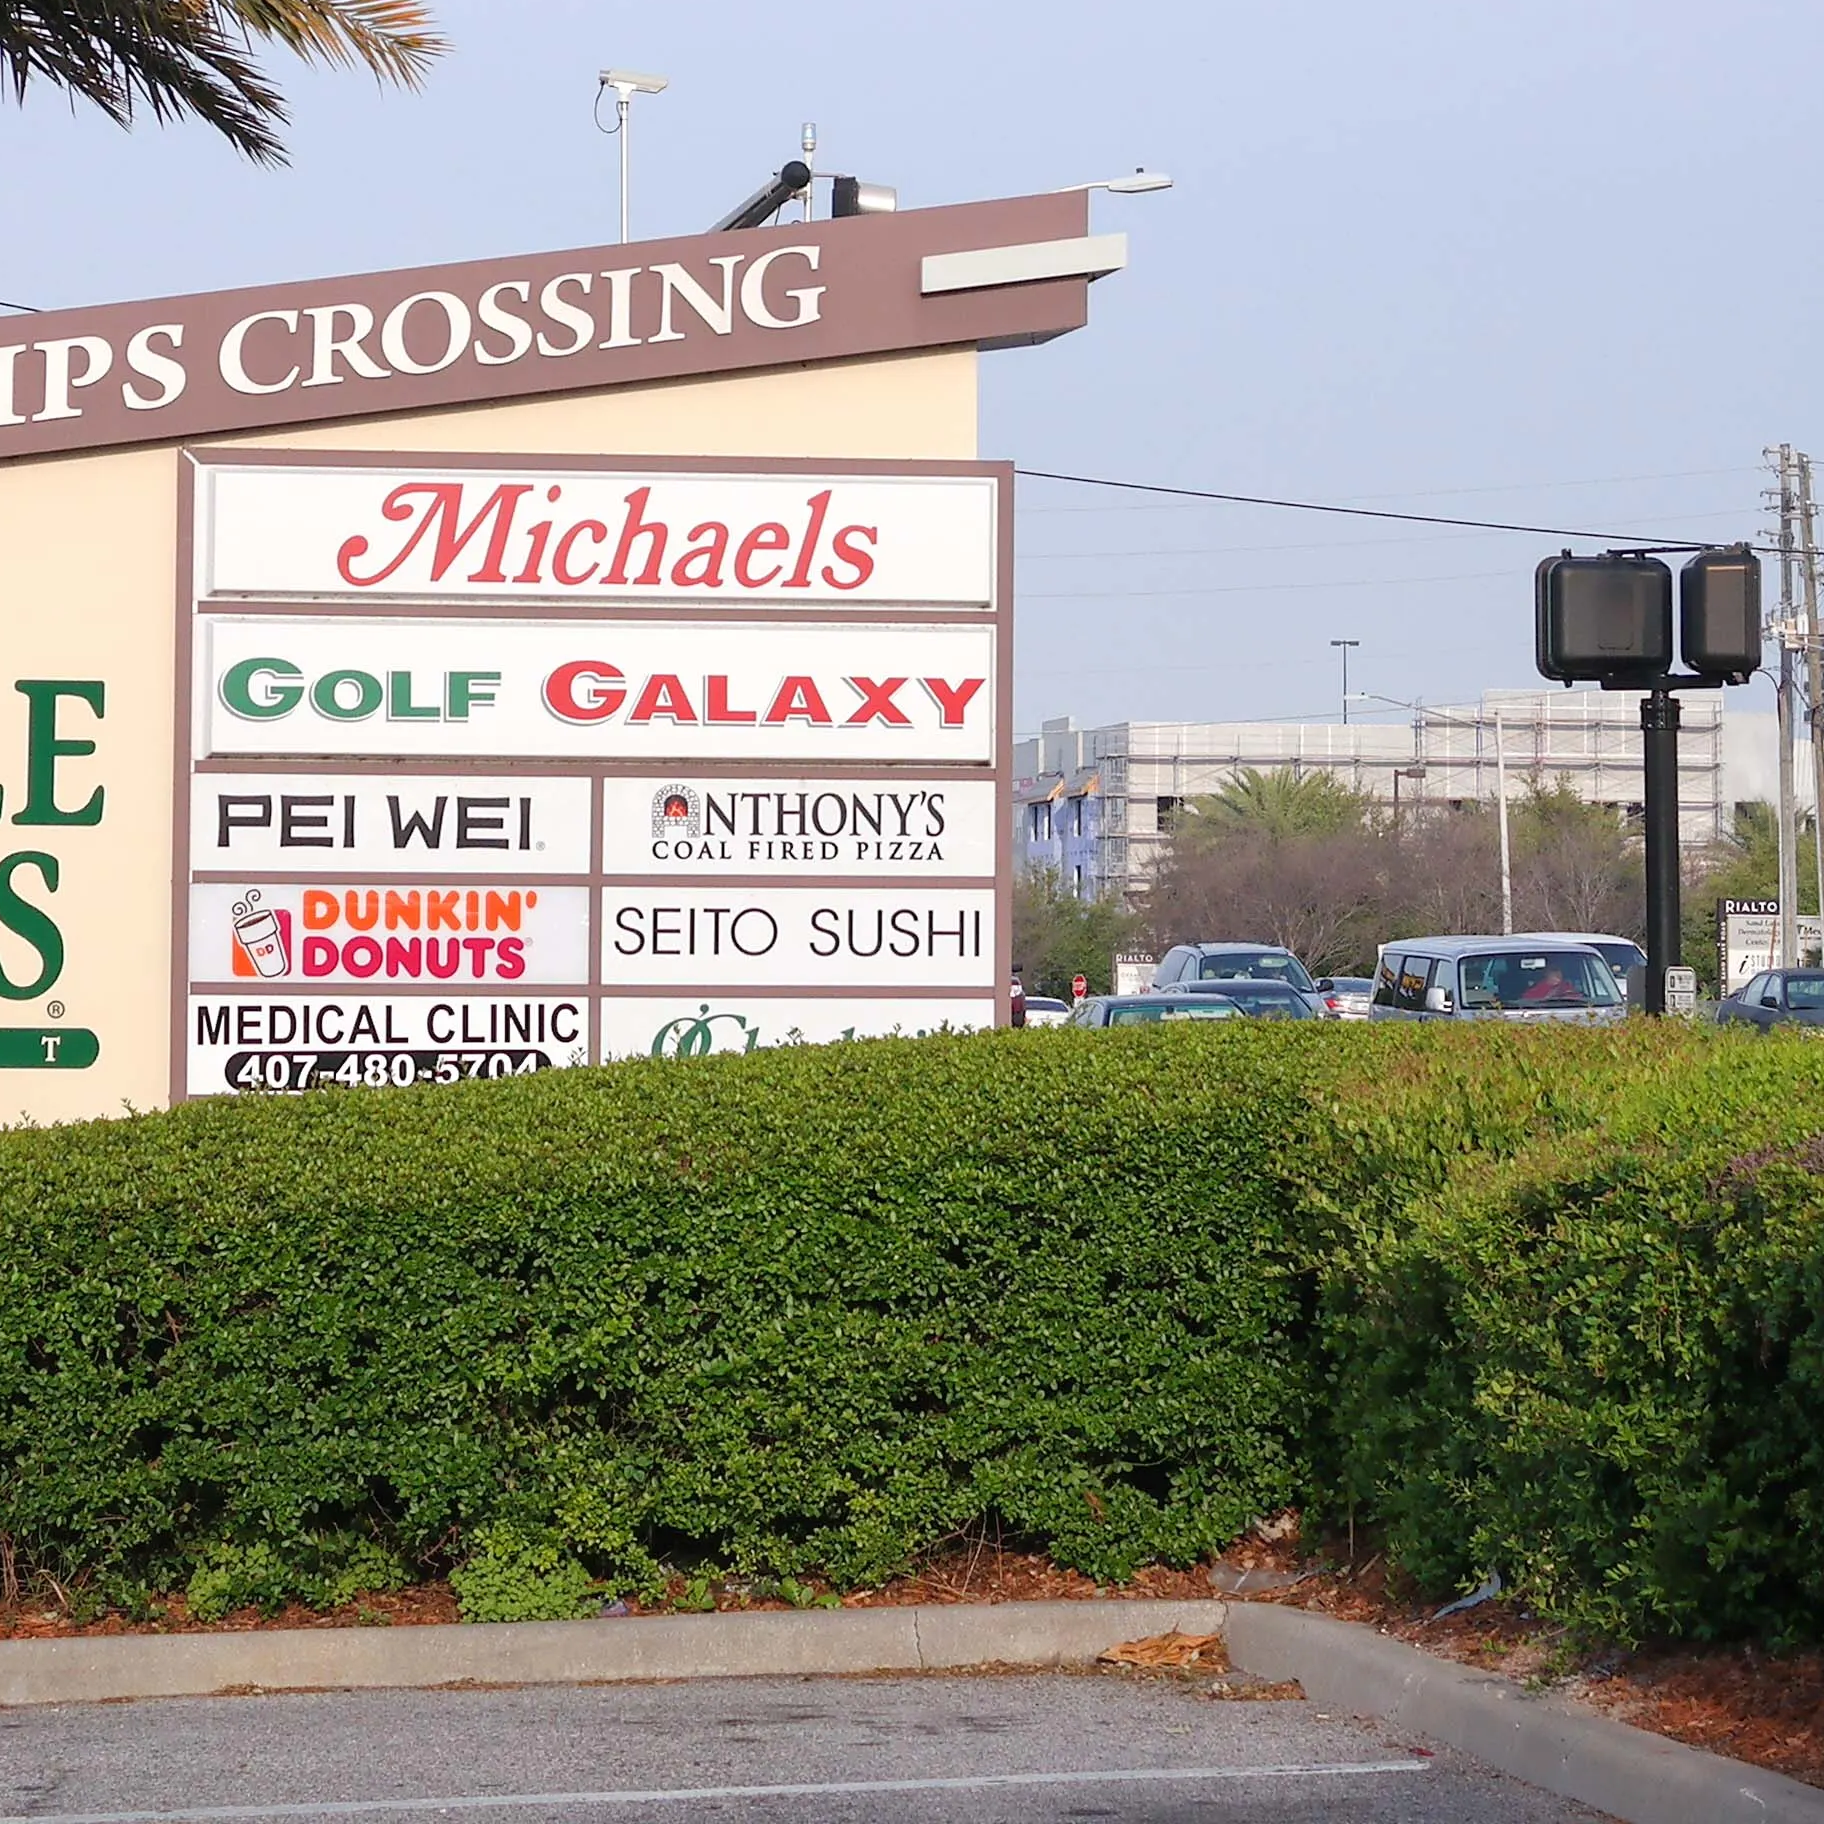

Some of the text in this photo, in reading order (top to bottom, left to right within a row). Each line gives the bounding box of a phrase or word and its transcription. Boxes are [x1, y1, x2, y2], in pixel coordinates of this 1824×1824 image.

[218, 244, 826, 395] CROSSING
[337, 481, 879, 591] Michaels
[218, 657, 987, 731] GOLF GALAXY
[216, 794, 532, 851] PEI WEI
[652, 840, 945, 861] COAL FIRED PIZZA
[302, 889, 538, 932] DUNKIN'
[1725, 900, 1778, 913] RIALTO
[256, 944, 274, 956] DD
[614, 907, 981, 958] SEITO SUSHI
[302, 936, 527, 980] DONUTS
[1116, 954, 1153, 962] RIALTO
[196, 1003, 580, 1046] MEDICAL CLINIC
